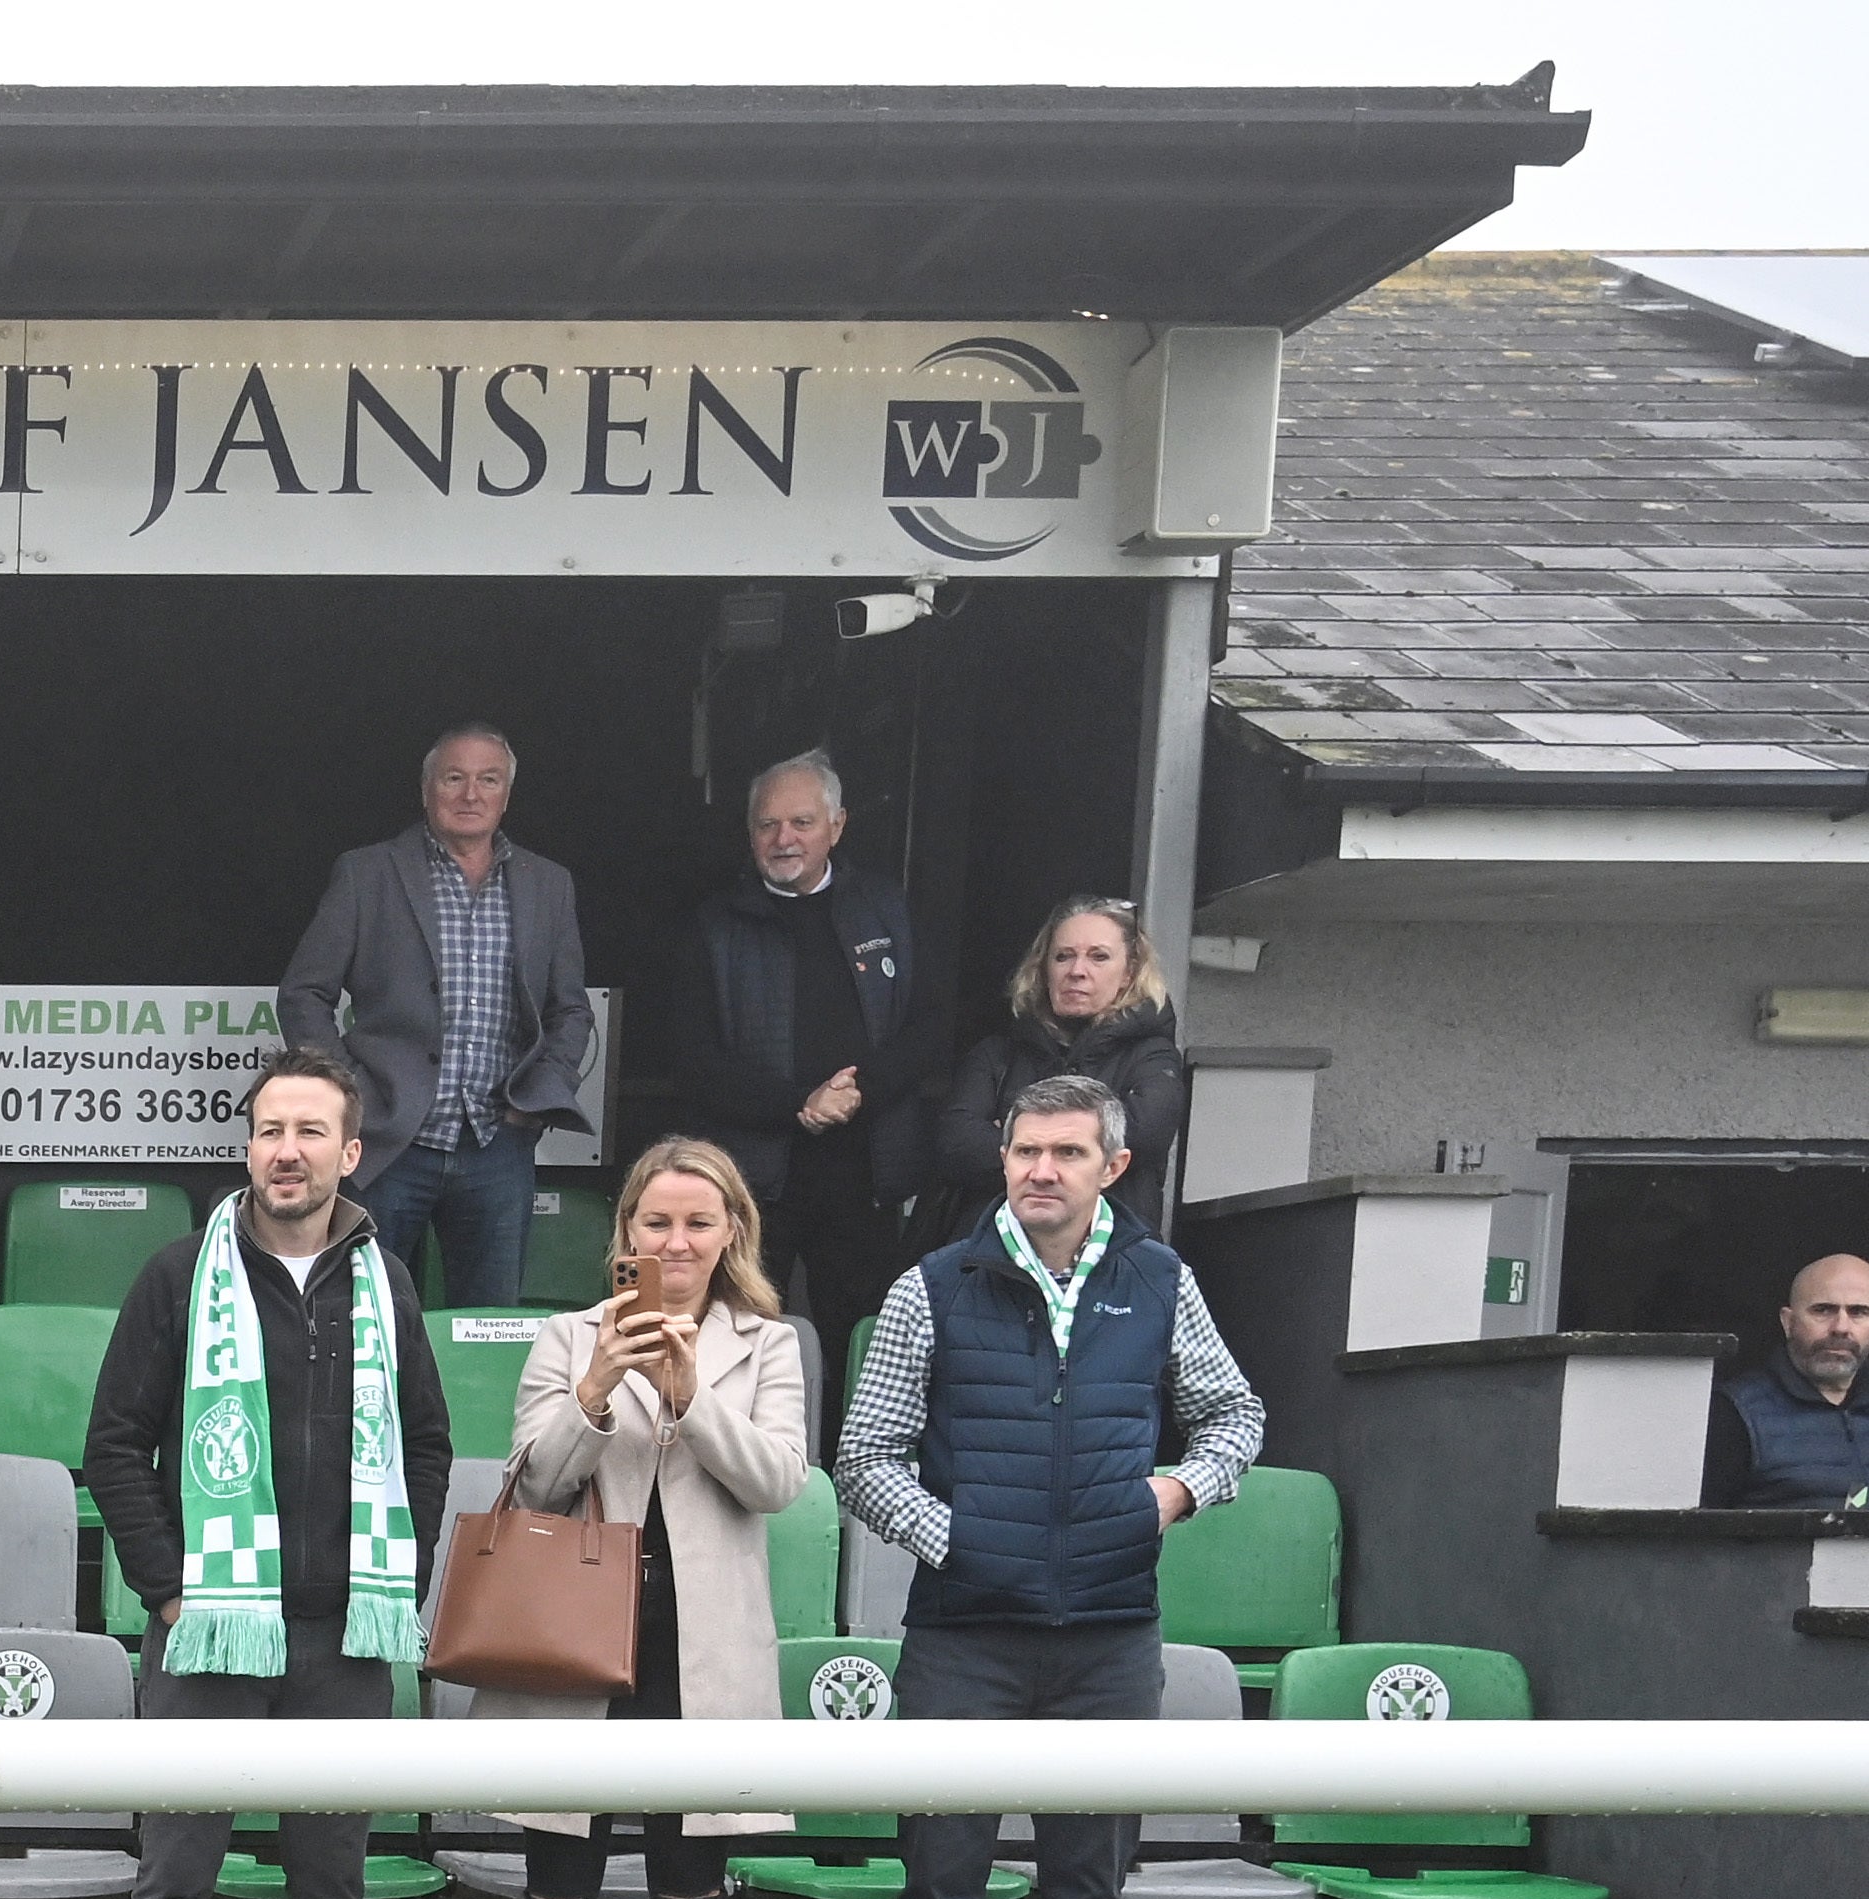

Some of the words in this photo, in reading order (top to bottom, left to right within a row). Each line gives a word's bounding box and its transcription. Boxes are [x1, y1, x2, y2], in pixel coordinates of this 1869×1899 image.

[129, 363, 813, 536] JANSEN
[4, 1000, 166, 1035] MEDIA
[0, 1087, 121, 1122] 01736
[19, 1145, 143, 1158] GREENMARKET
[146, 1146, 237, 1158] PENZANCE
[81, 1189, 126, 1197] Reserved
[69, 1200, 96, 1209] Away
[98, 1200, 137, 1208] Director
[475, 1319, 524, 1328] Reserved
[464, 1331, 491, 1341] Away
[494, 1331, 535, 1340] Director
[814, 1658, 886, 1688] MOUSEHOLE
[1372, 1667, 1445, 1696] MOUSEHOLE
